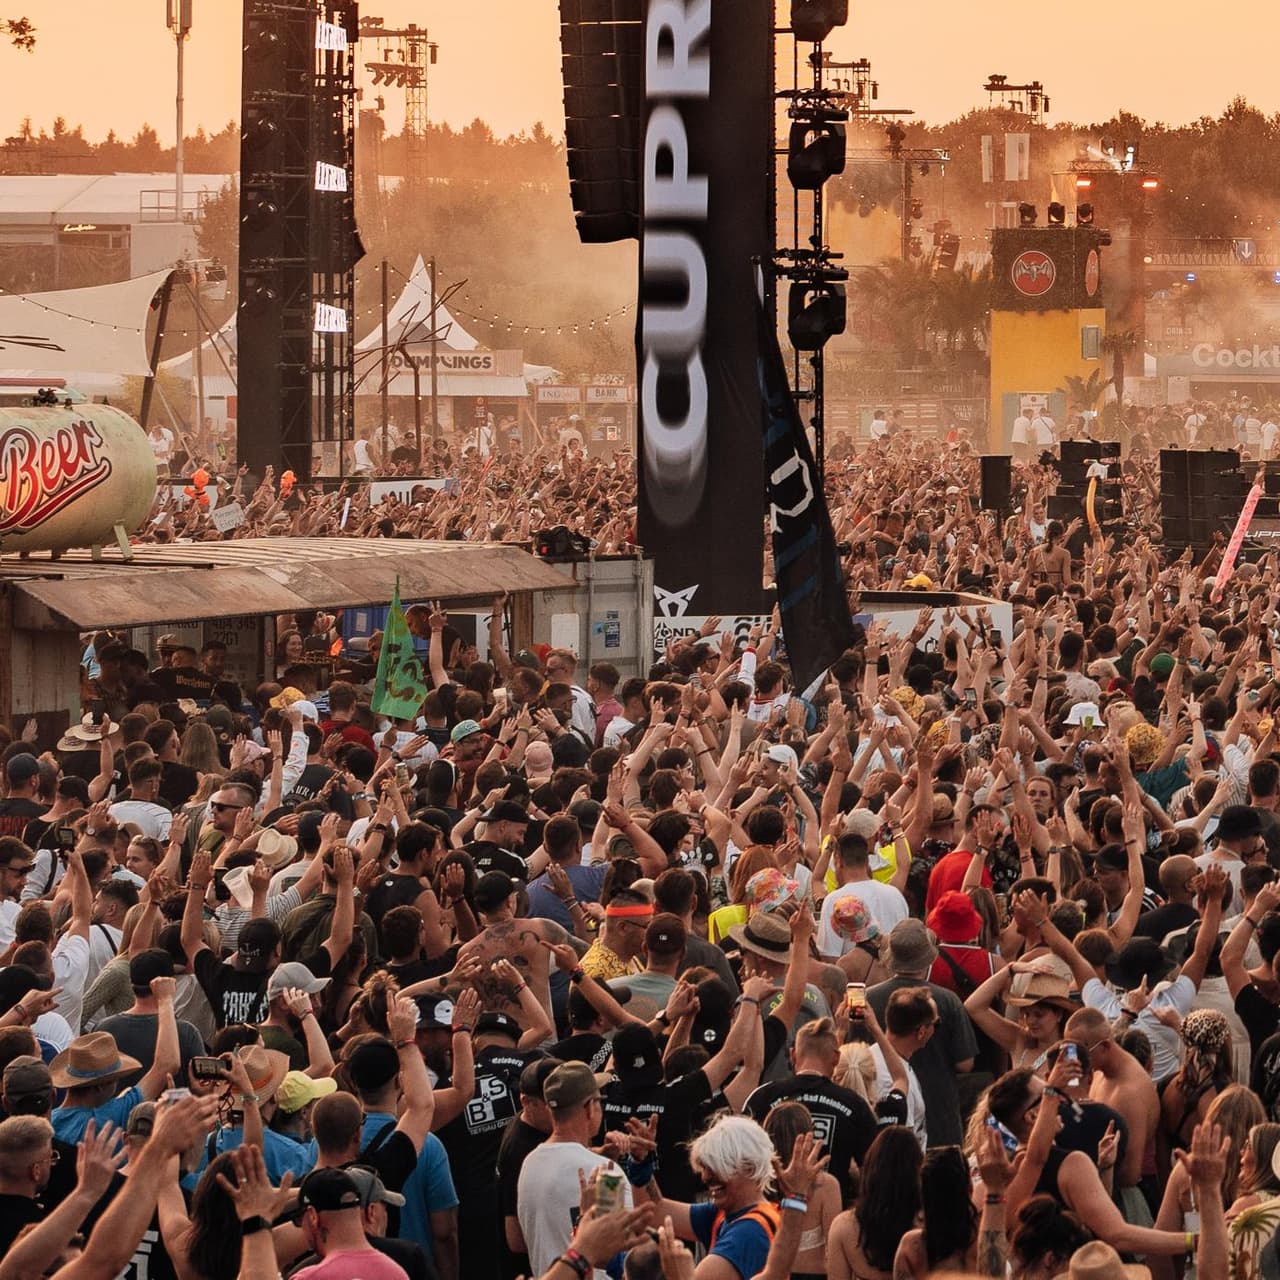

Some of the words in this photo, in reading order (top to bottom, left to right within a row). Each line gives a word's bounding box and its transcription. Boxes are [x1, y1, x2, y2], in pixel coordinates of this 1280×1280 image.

[393, 356, 492, 369] DUMPLINGS
[595, 389, 618, 398] BANK
[1, 421, 102, 517] Beer
